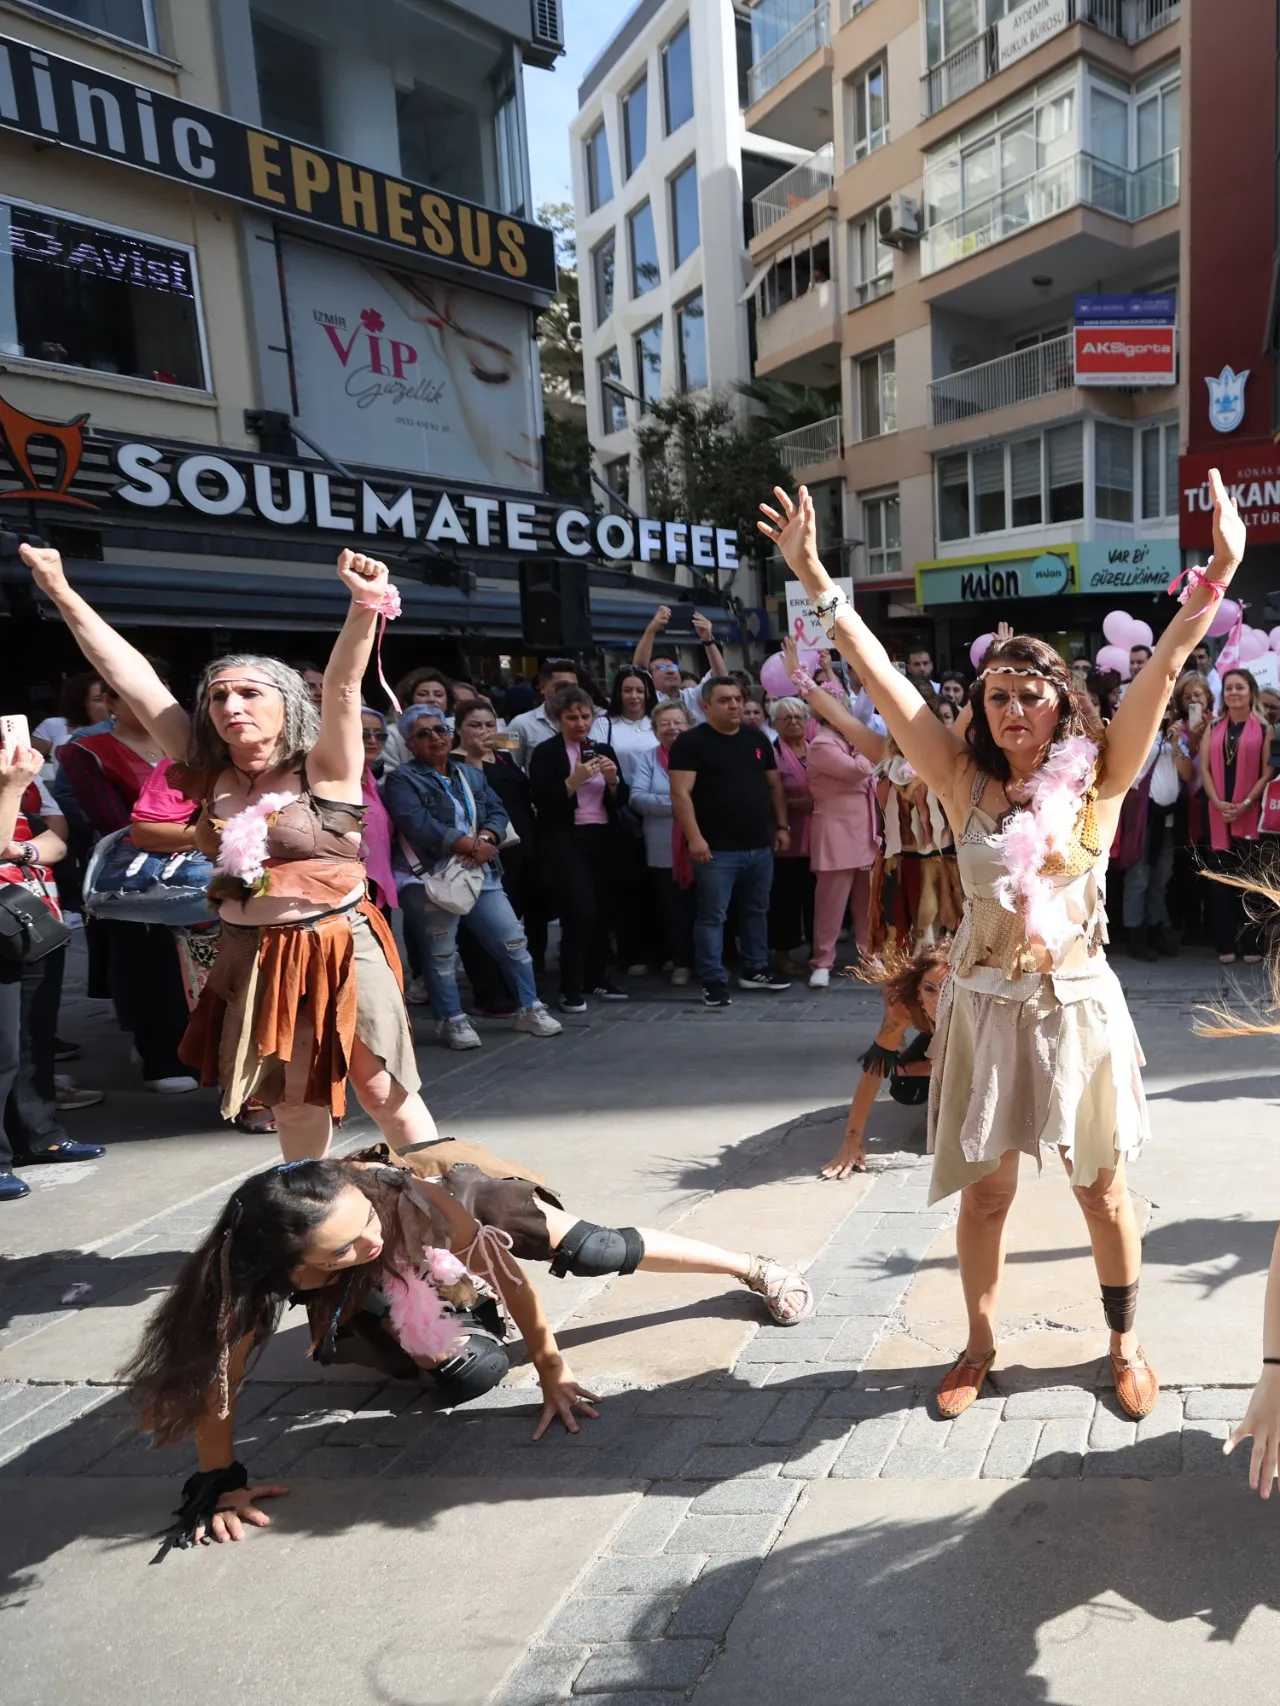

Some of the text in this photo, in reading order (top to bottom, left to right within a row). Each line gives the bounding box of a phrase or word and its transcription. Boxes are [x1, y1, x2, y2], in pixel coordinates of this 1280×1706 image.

[246, 130, 528, 279] EPHESUS
[1237, 465, 1274, 478] KONAK
[116, 443, 741, 570] SOULMATE COFFEE
[1241, 509, 1280, 527] LTÜR
[1108, 549, 1130, 564] VAR
[790, 599, 812, 607] ERKE
